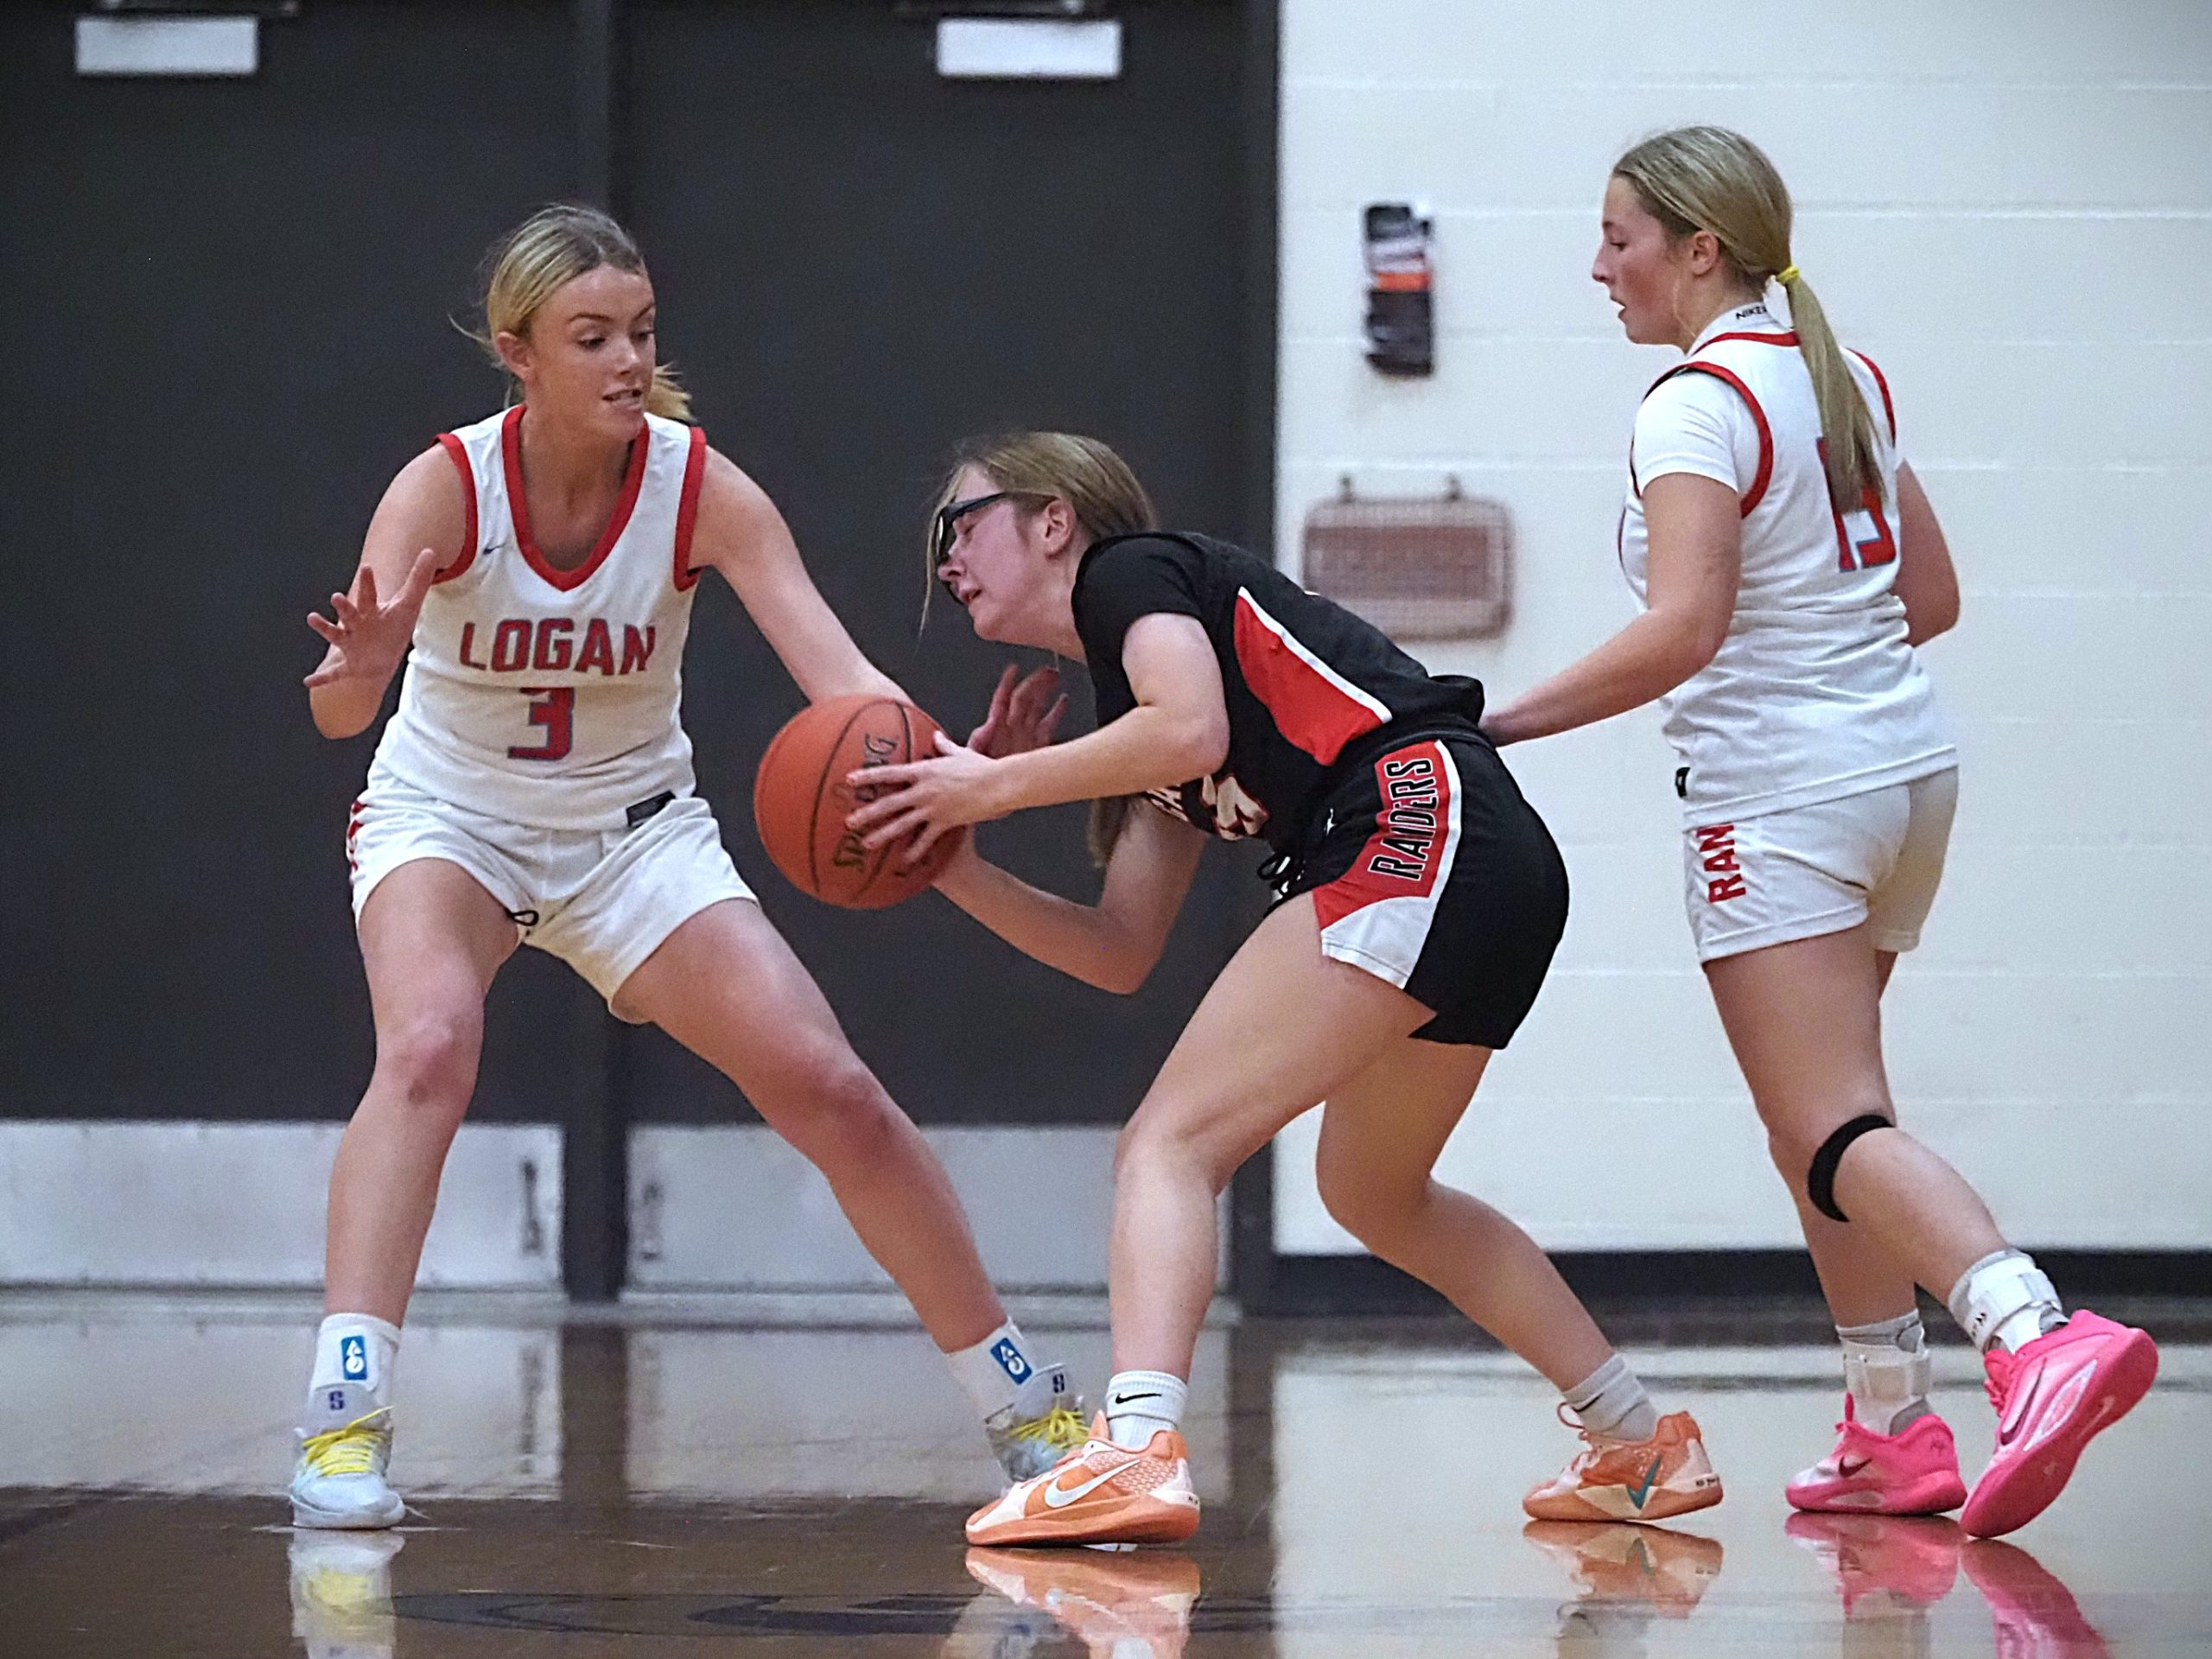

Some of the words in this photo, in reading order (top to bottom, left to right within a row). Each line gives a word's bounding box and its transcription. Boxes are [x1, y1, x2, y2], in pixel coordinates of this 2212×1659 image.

[460, 618, 656, 676] LOGAN
[507, 687, 575, 761] 3
[1368, 758, 1439, 881] RAIDERS
